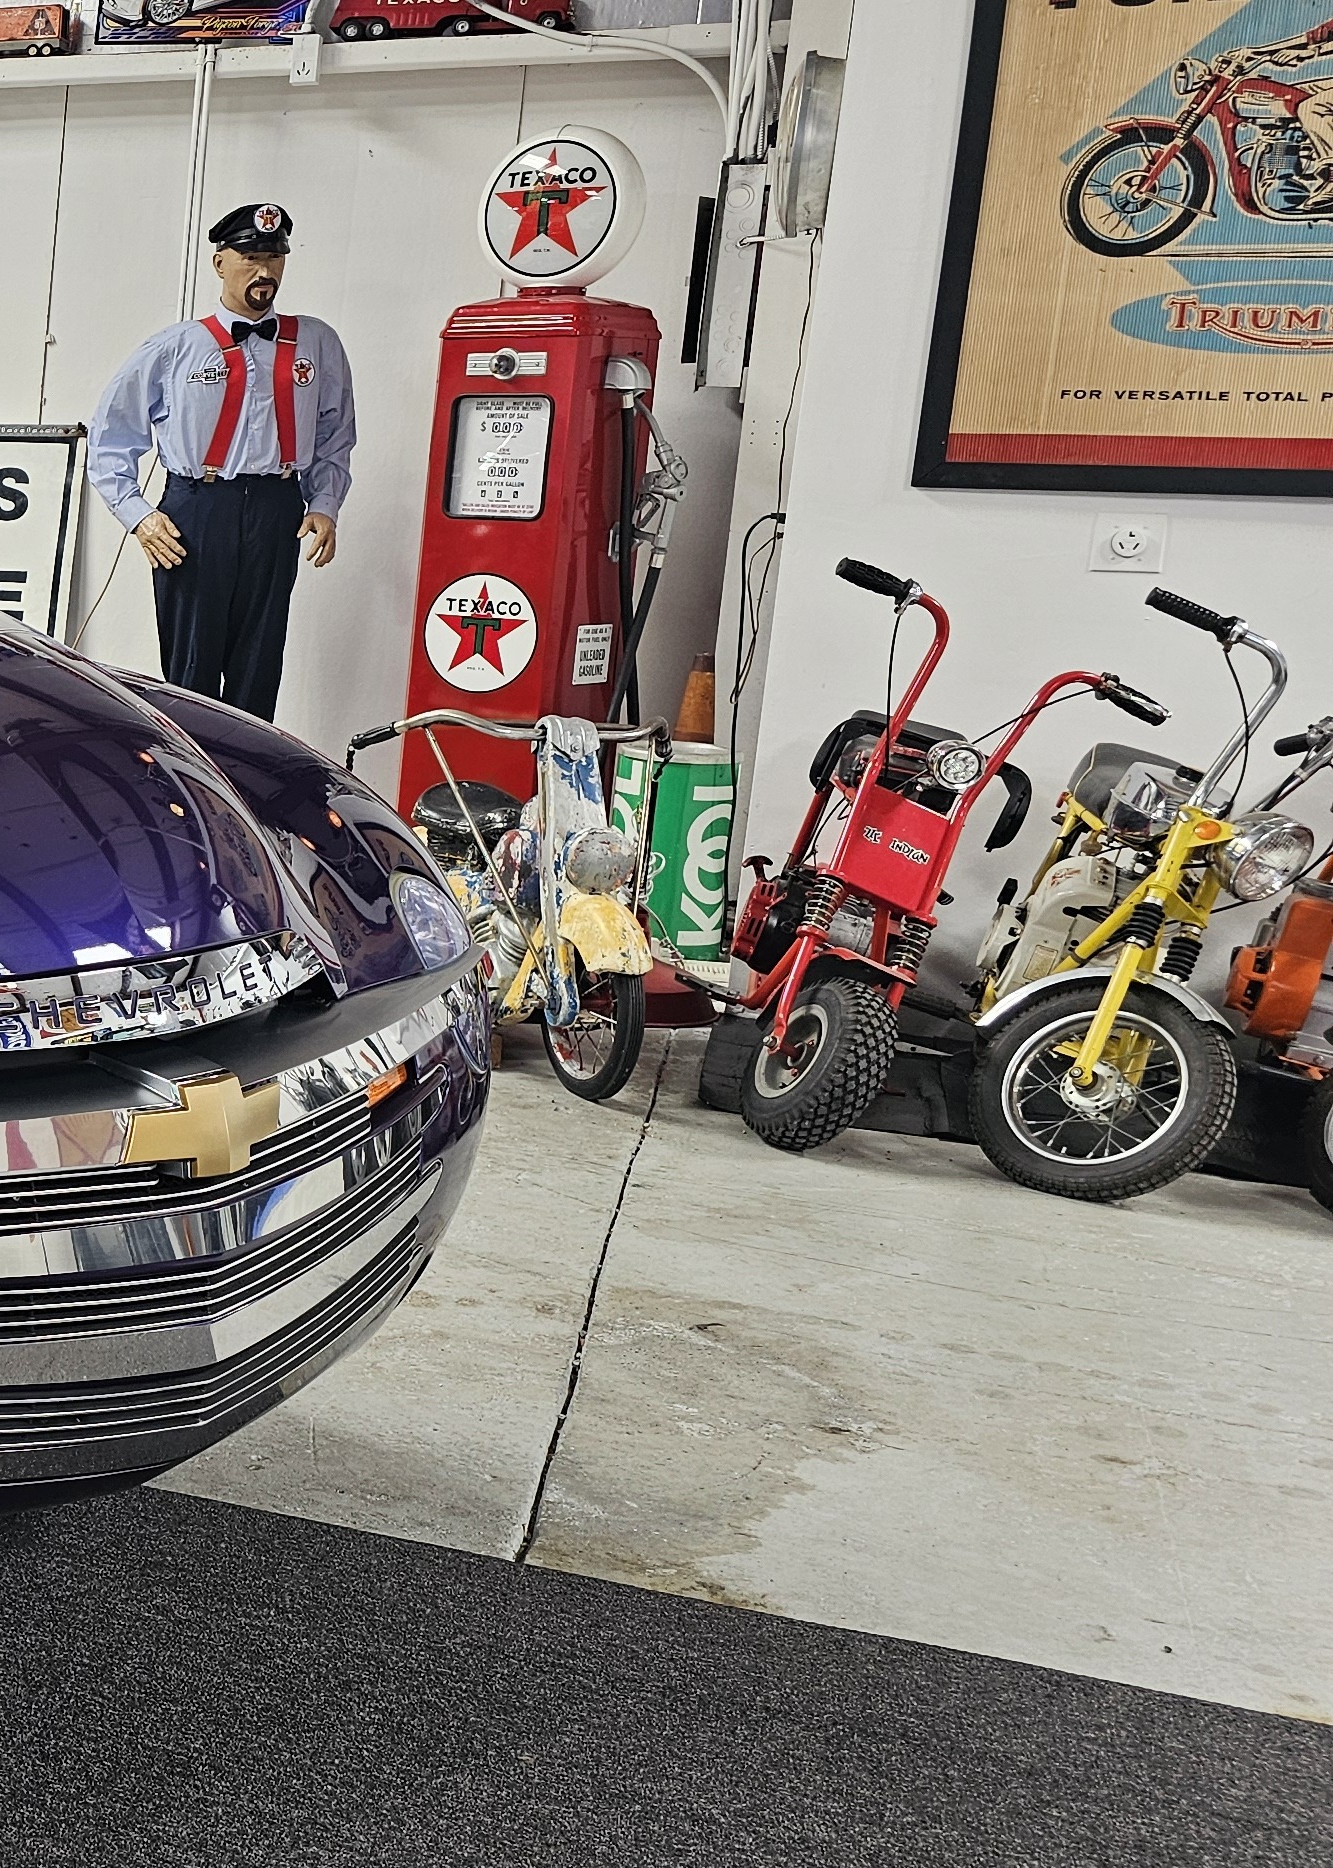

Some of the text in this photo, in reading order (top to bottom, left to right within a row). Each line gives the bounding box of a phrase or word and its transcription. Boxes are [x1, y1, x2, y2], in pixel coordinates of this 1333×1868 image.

[508, 166, 597, 189] TEXACO
[1165, 294, 1333, 333] TRIUM
[1060, 390, 1102, 400] FOR
[1114, 390, 1230, 401] VERSATILE
[1243, 391, 1308, 402] TOTAL
[446, 597, 522, 616] TEXACO
[580, 649, 606, 662] UNLEADED
[578, 664, 604, 677] GASOLINE
[890, 838, 930, 864] INDIAN
